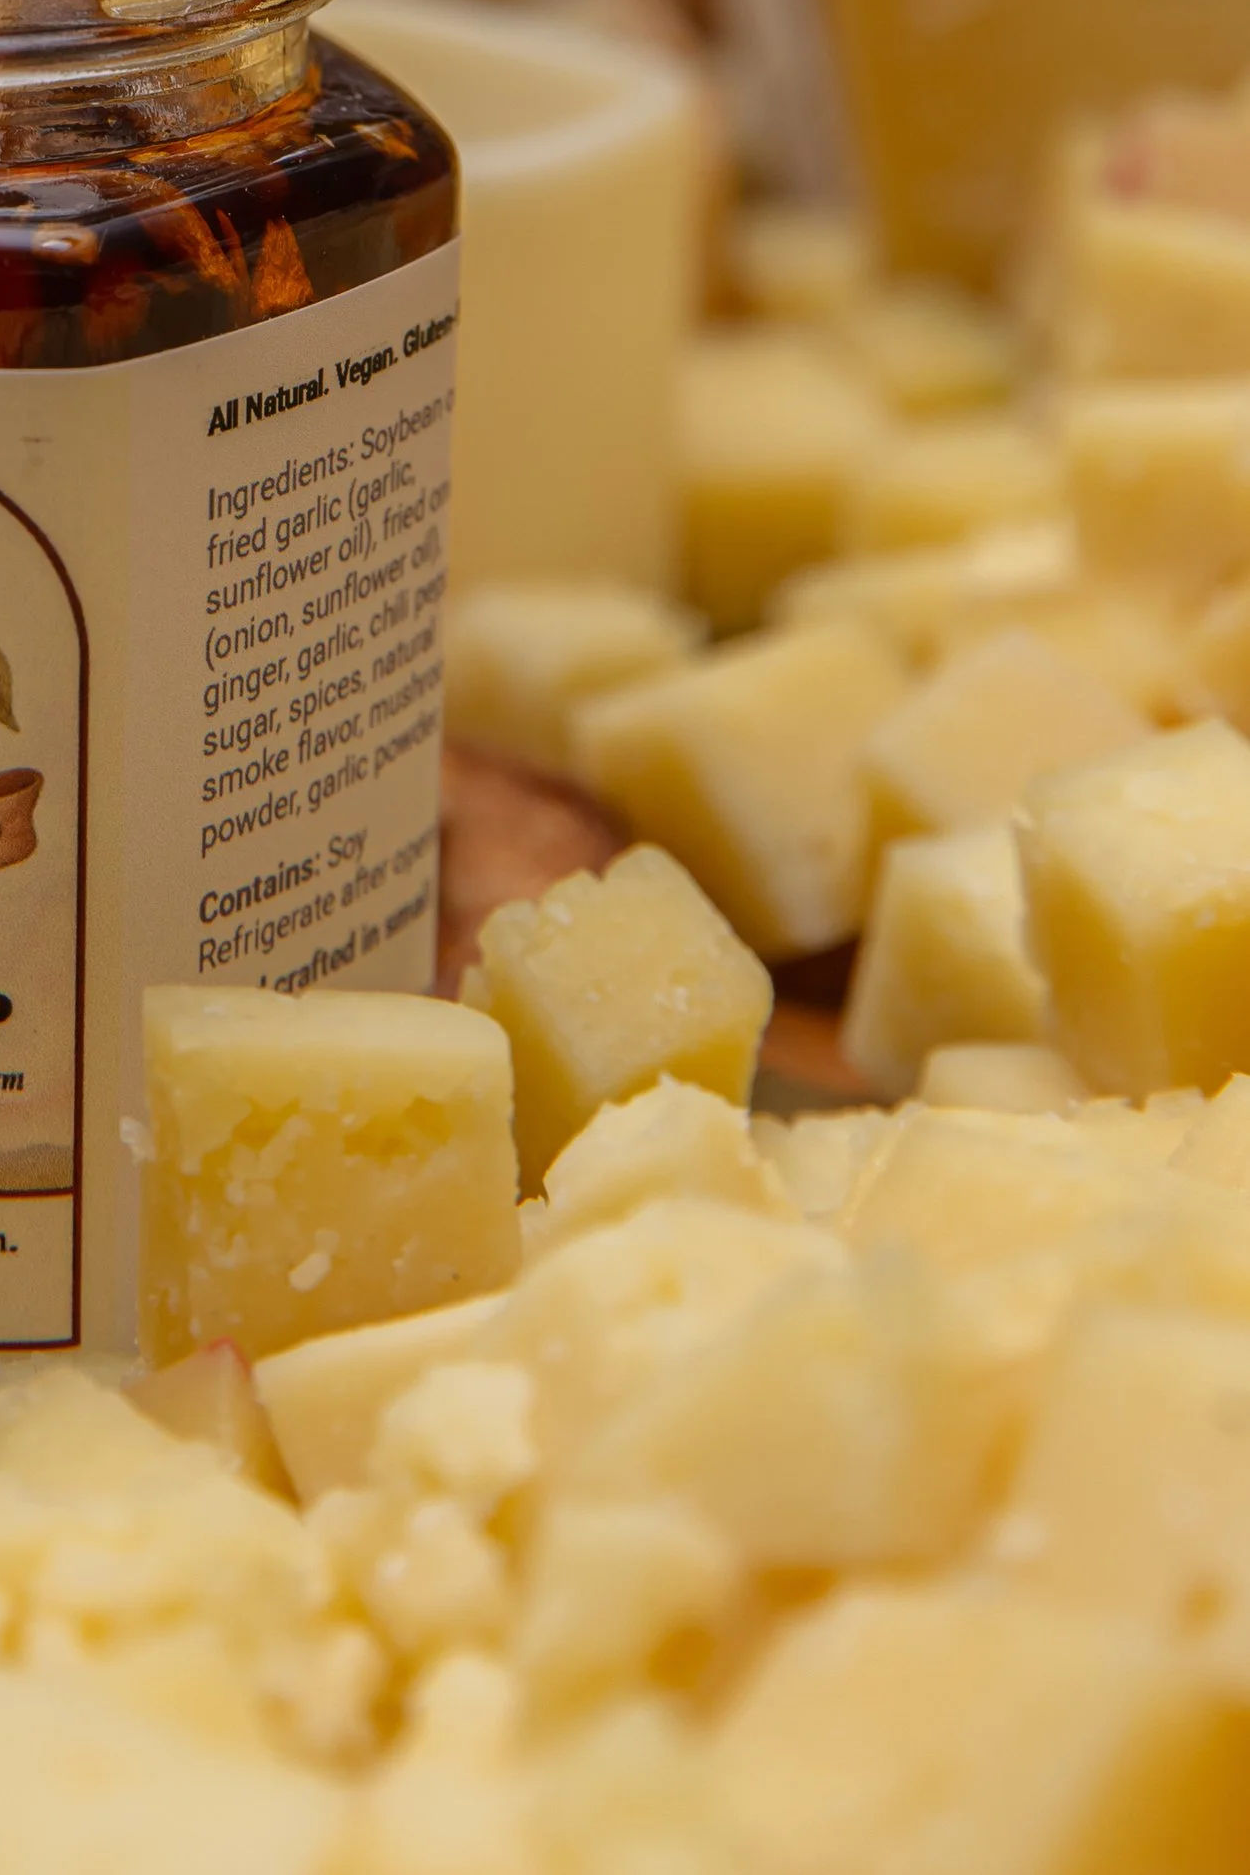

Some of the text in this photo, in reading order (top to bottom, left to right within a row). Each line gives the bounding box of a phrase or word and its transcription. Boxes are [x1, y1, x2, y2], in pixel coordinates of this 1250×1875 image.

[207, 397, 239, 437] All
[245, 367, 330, 424] Natural.
[334, 346, 399, 388] Vegan.
[207, 441, 354, 521] Ingredients:
[360, 397, 444, 460] Soybean
[205, 545, 333, 615] sunflower
[338, 518, 378, 561] oil),
[382, 486, 426, 541] fried
[207, 516, 267, 570] fried
[275, 494, 342, 552] garlic
[205, 611, 295, 672] (onion,
[301, 553, 407, 626] sunflower
[202, 706, 282, 757] sugar,
[289, 668, 367, 726] spices,
[203, 655, 290, 717] ginger,
[297, 623, 365, 681] garlic,
[201, 747, 289, 802] smoke
[296, 711, 365, 765] flavor,
[201, 790, 301, 859] powder,
[307, 754, 369, 813] garlic
[199, 828, 368, 924] Contains: Soy
[199, 891, 336, 974] Refrigerate
